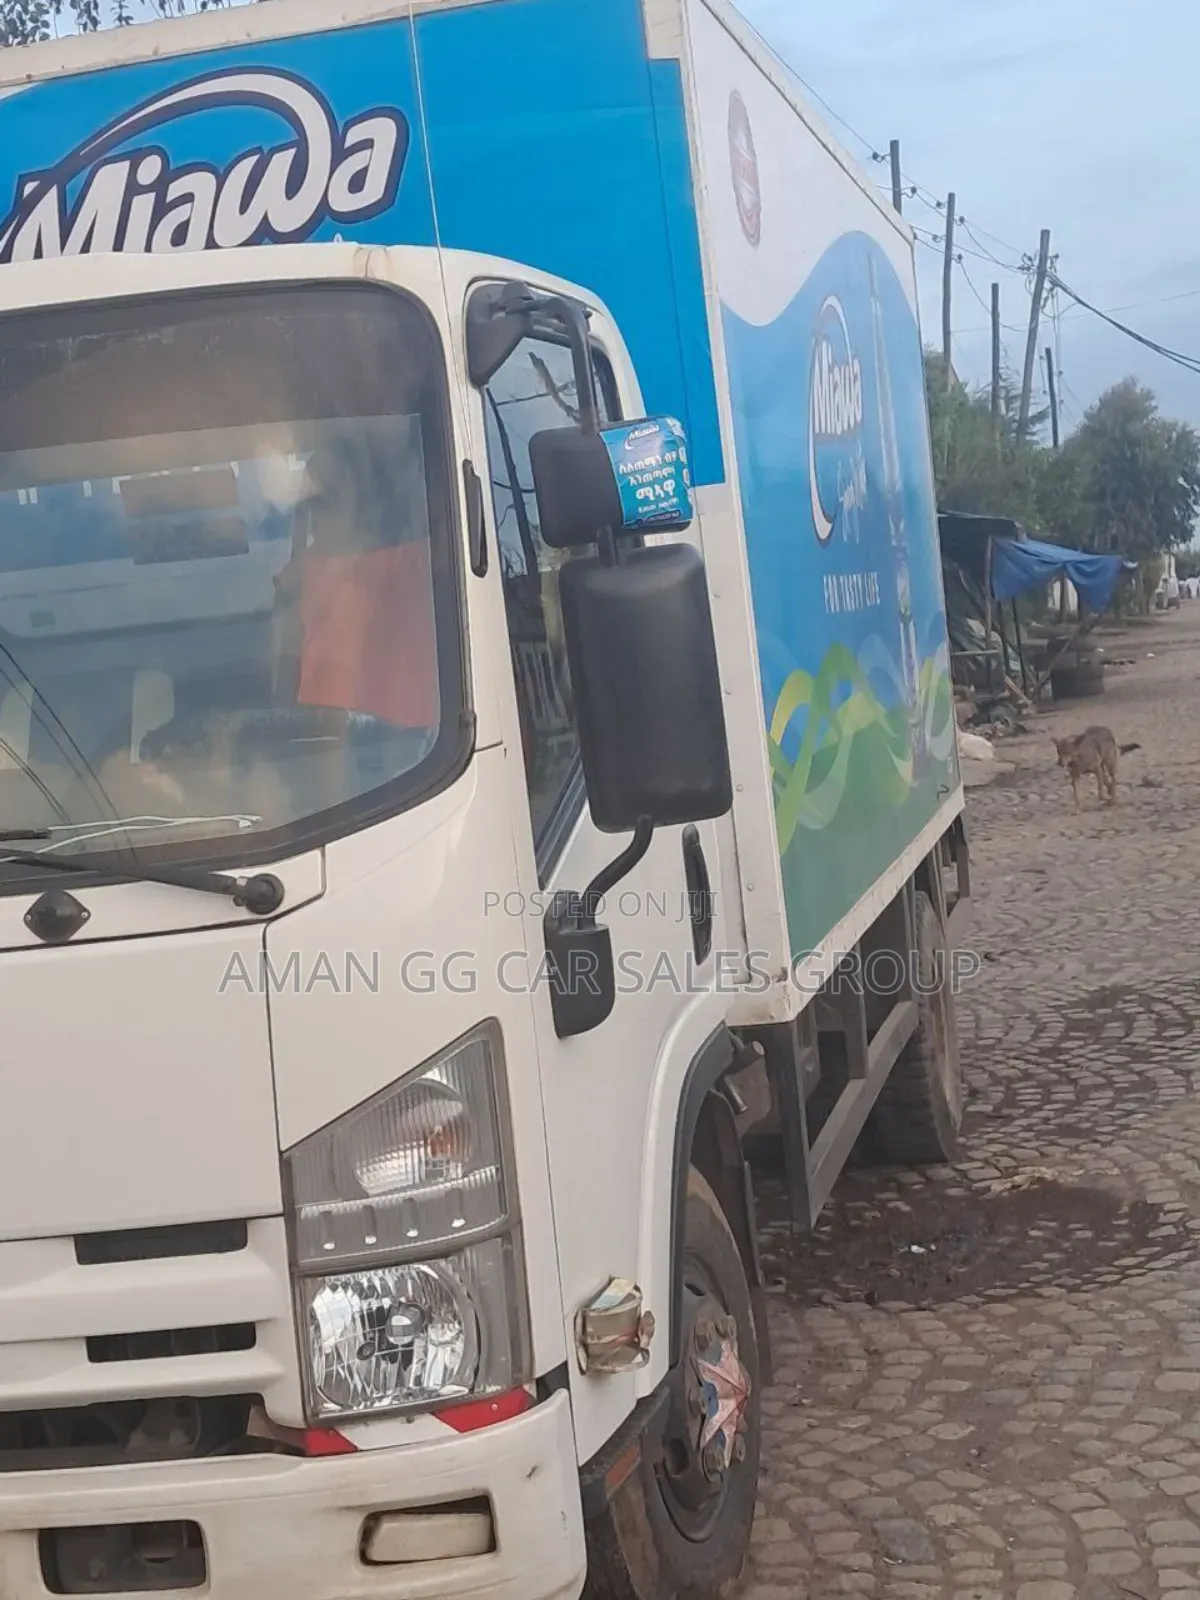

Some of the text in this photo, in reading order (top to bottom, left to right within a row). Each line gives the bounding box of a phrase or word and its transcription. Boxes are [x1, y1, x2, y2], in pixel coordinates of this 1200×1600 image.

[0, 73, 399, 262] Miawa
[812, 335, 862, 436] Miawa
[823, 574, 840, 614] FOR
